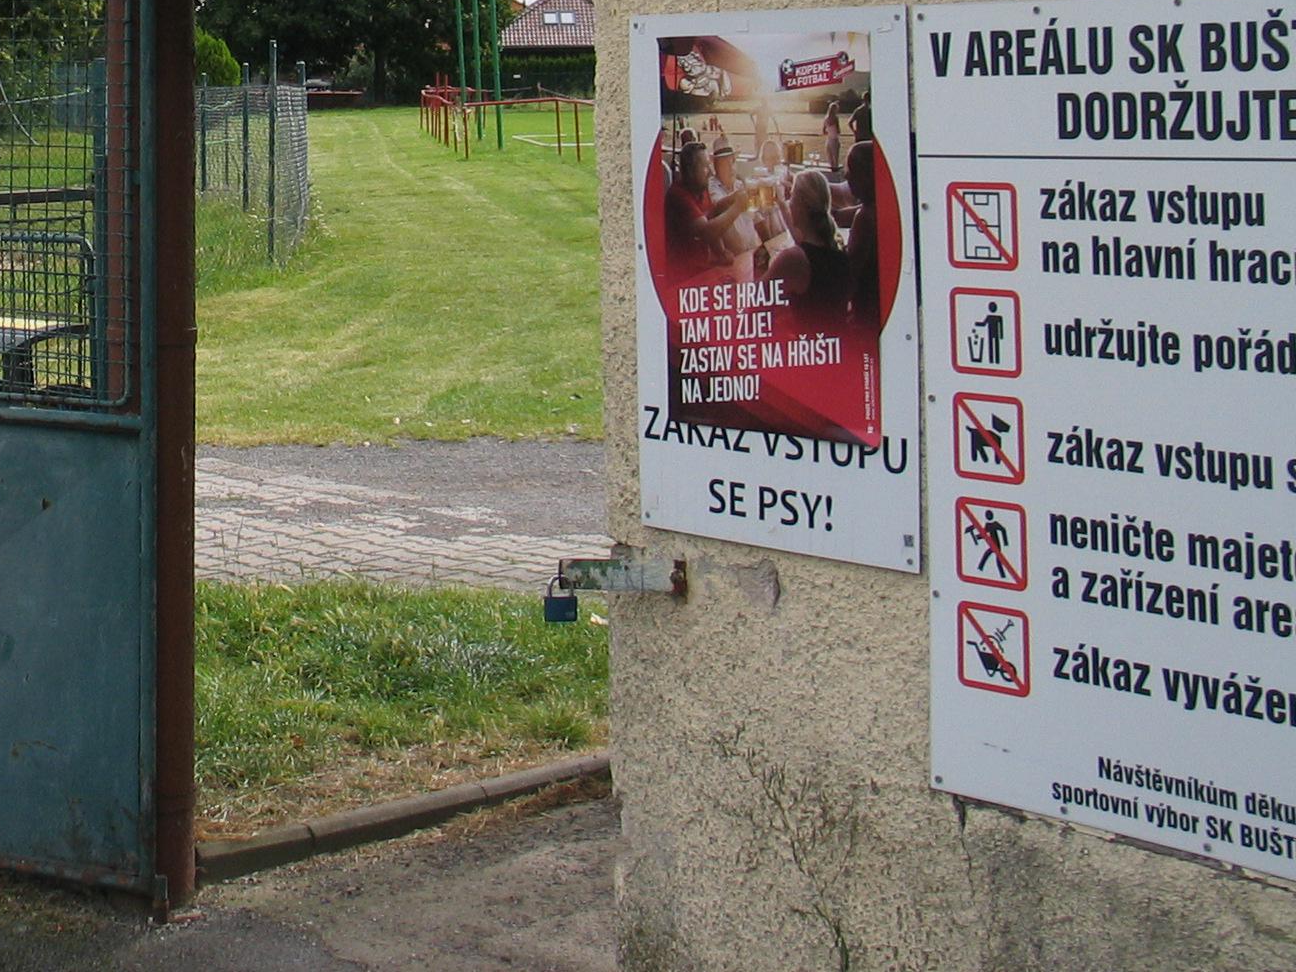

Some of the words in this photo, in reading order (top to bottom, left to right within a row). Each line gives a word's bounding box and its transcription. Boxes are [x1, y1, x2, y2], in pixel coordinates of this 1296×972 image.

[795, 61, 831, 76] KOPEME
[930, 32, 952, 77] V
[964, 17, 1113, 77] AREÁLU
[1129, 23, 1185, 74] SK
[1200, 8, 1296, 73] BUŠ
[797, 73, 829, 86] FOTBAL
[1057, 79, 1296, 141] DODRŽUJTE
[1040, 180, 1136, 222] zákaz
[1147, 185, 1265, 230] vstupu
[1042, 240, 1080, 274] na
[1092, 235, 1197, 280] hlavní
[1209, 240, 1296, 286] hrac
[679, 286, 709, 313] KDE
[713, 285, 732, 310] SE
[736, 279, 789, 308] HRAJE,
[679, 317, 710, 344] TAM
[713, 315, 732, 341] TO
[736, 309, 772, 339] ŽIJE!
[1044, 318, 1181, 368] udržujte
[680, 346, 733, 374] ZASTAV
[737, 344, 757, 370] SE
[762, 342, 783, 368] NA
[788, 333, 840, 367] HŘIŠTI
[681, 378, 702, 403] NA
[706, 375, 760, 403] JEDNO!
[1047, 426, 1144, 474] zákaz
[1155, 441, 1273, 491] vstupu
[708, 478, 747, 518] SE
[759, 486, 833, 532] PSY!
[1049, 513, 1175, 562] neničte
[1188, 531, 1296, 582] majet
[1052, 566, 1070, 599] a
[1081, 568, 1219, 625] zařízení
[1233, 595, 1296, 638] are
[1053, 643, 1152, 697] zákaz
[1097, 756, 1238, 811] Návštěvníkům
[1052, 782, 1139, 819] sportovní
[1145, 802, 1200, 834] výbor
[1206, 815, 1234, 843] SK
